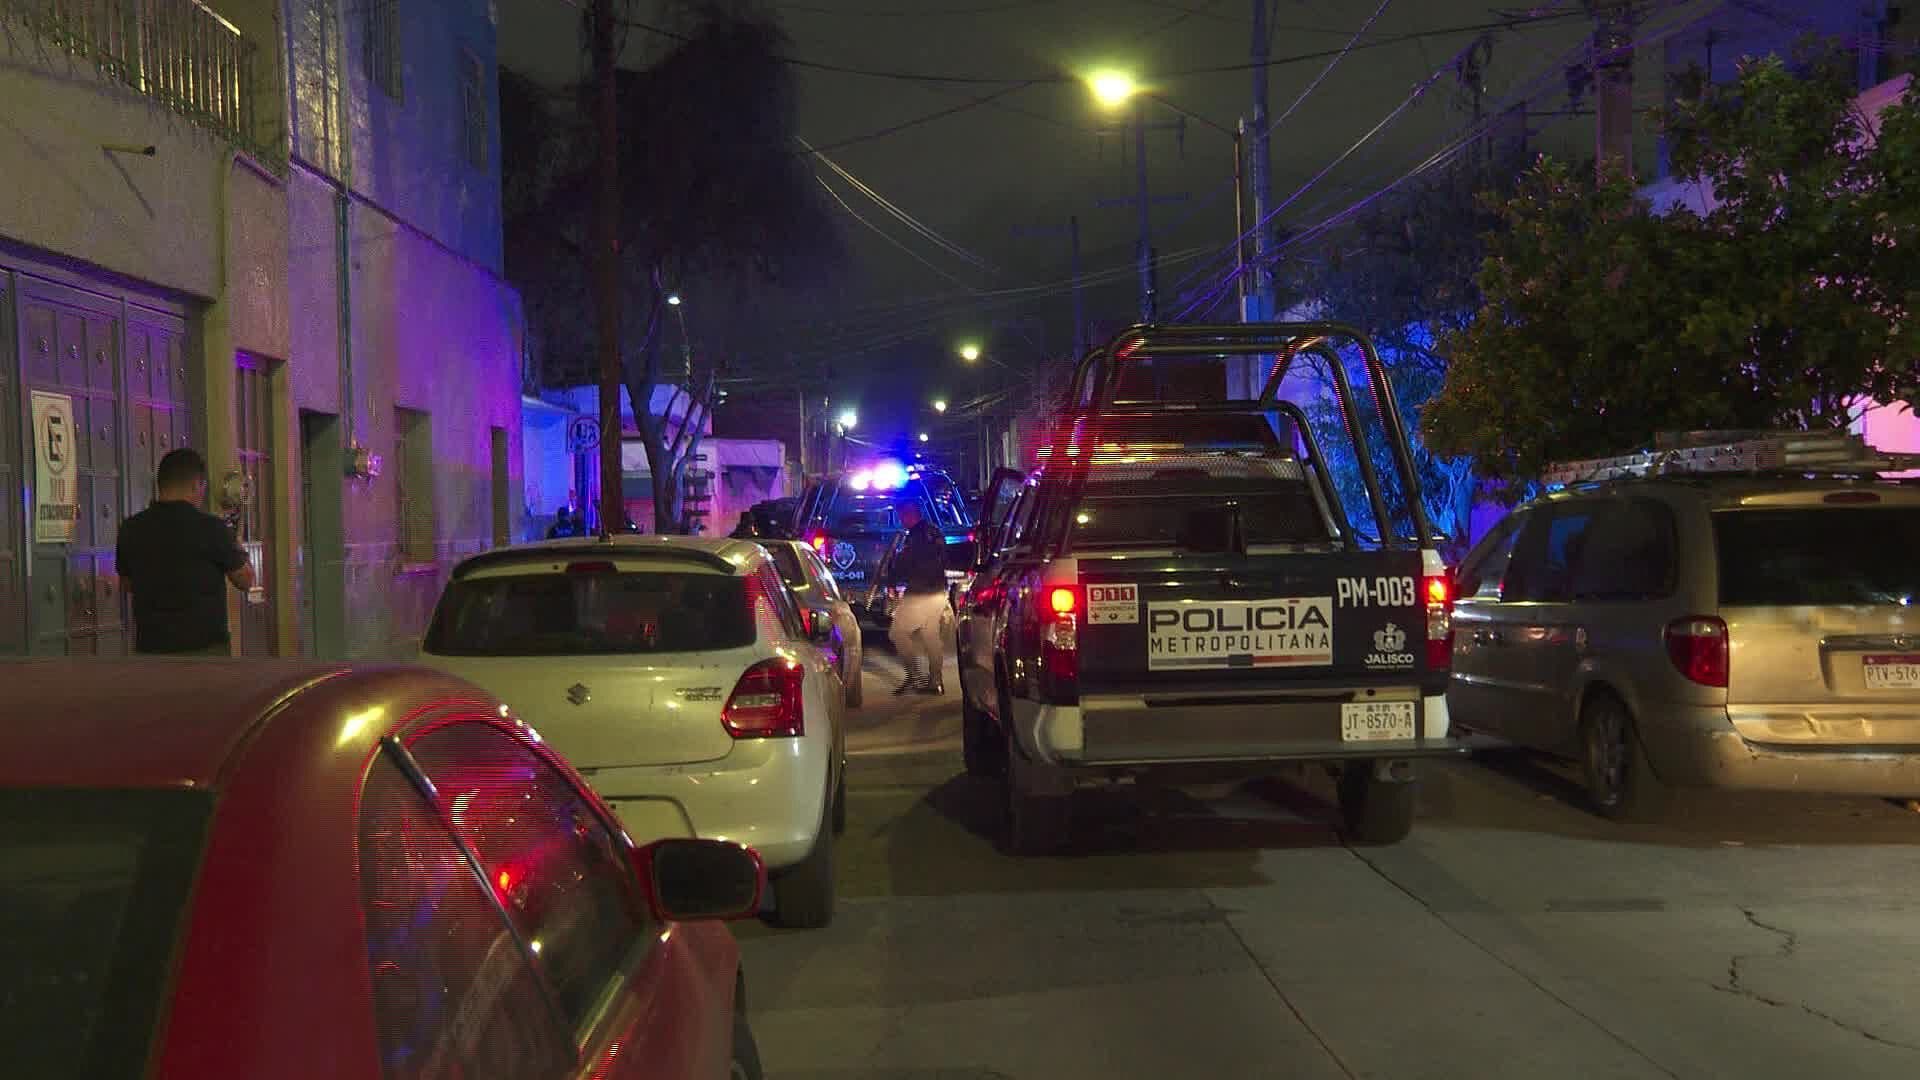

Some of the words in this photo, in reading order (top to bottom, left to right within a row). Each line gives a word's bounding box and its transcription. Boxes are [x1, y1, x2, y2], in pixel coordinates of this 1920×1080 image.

[1092, 588, 1131, 601] 911
[1337, 576, 1416, 608] PM-003
[1150, 633, 1330, 653] METROPOLITANA
[1364, 653, 1415, 665] JALISCO
[1345, 711, 1412, 730] JT-8570-A
